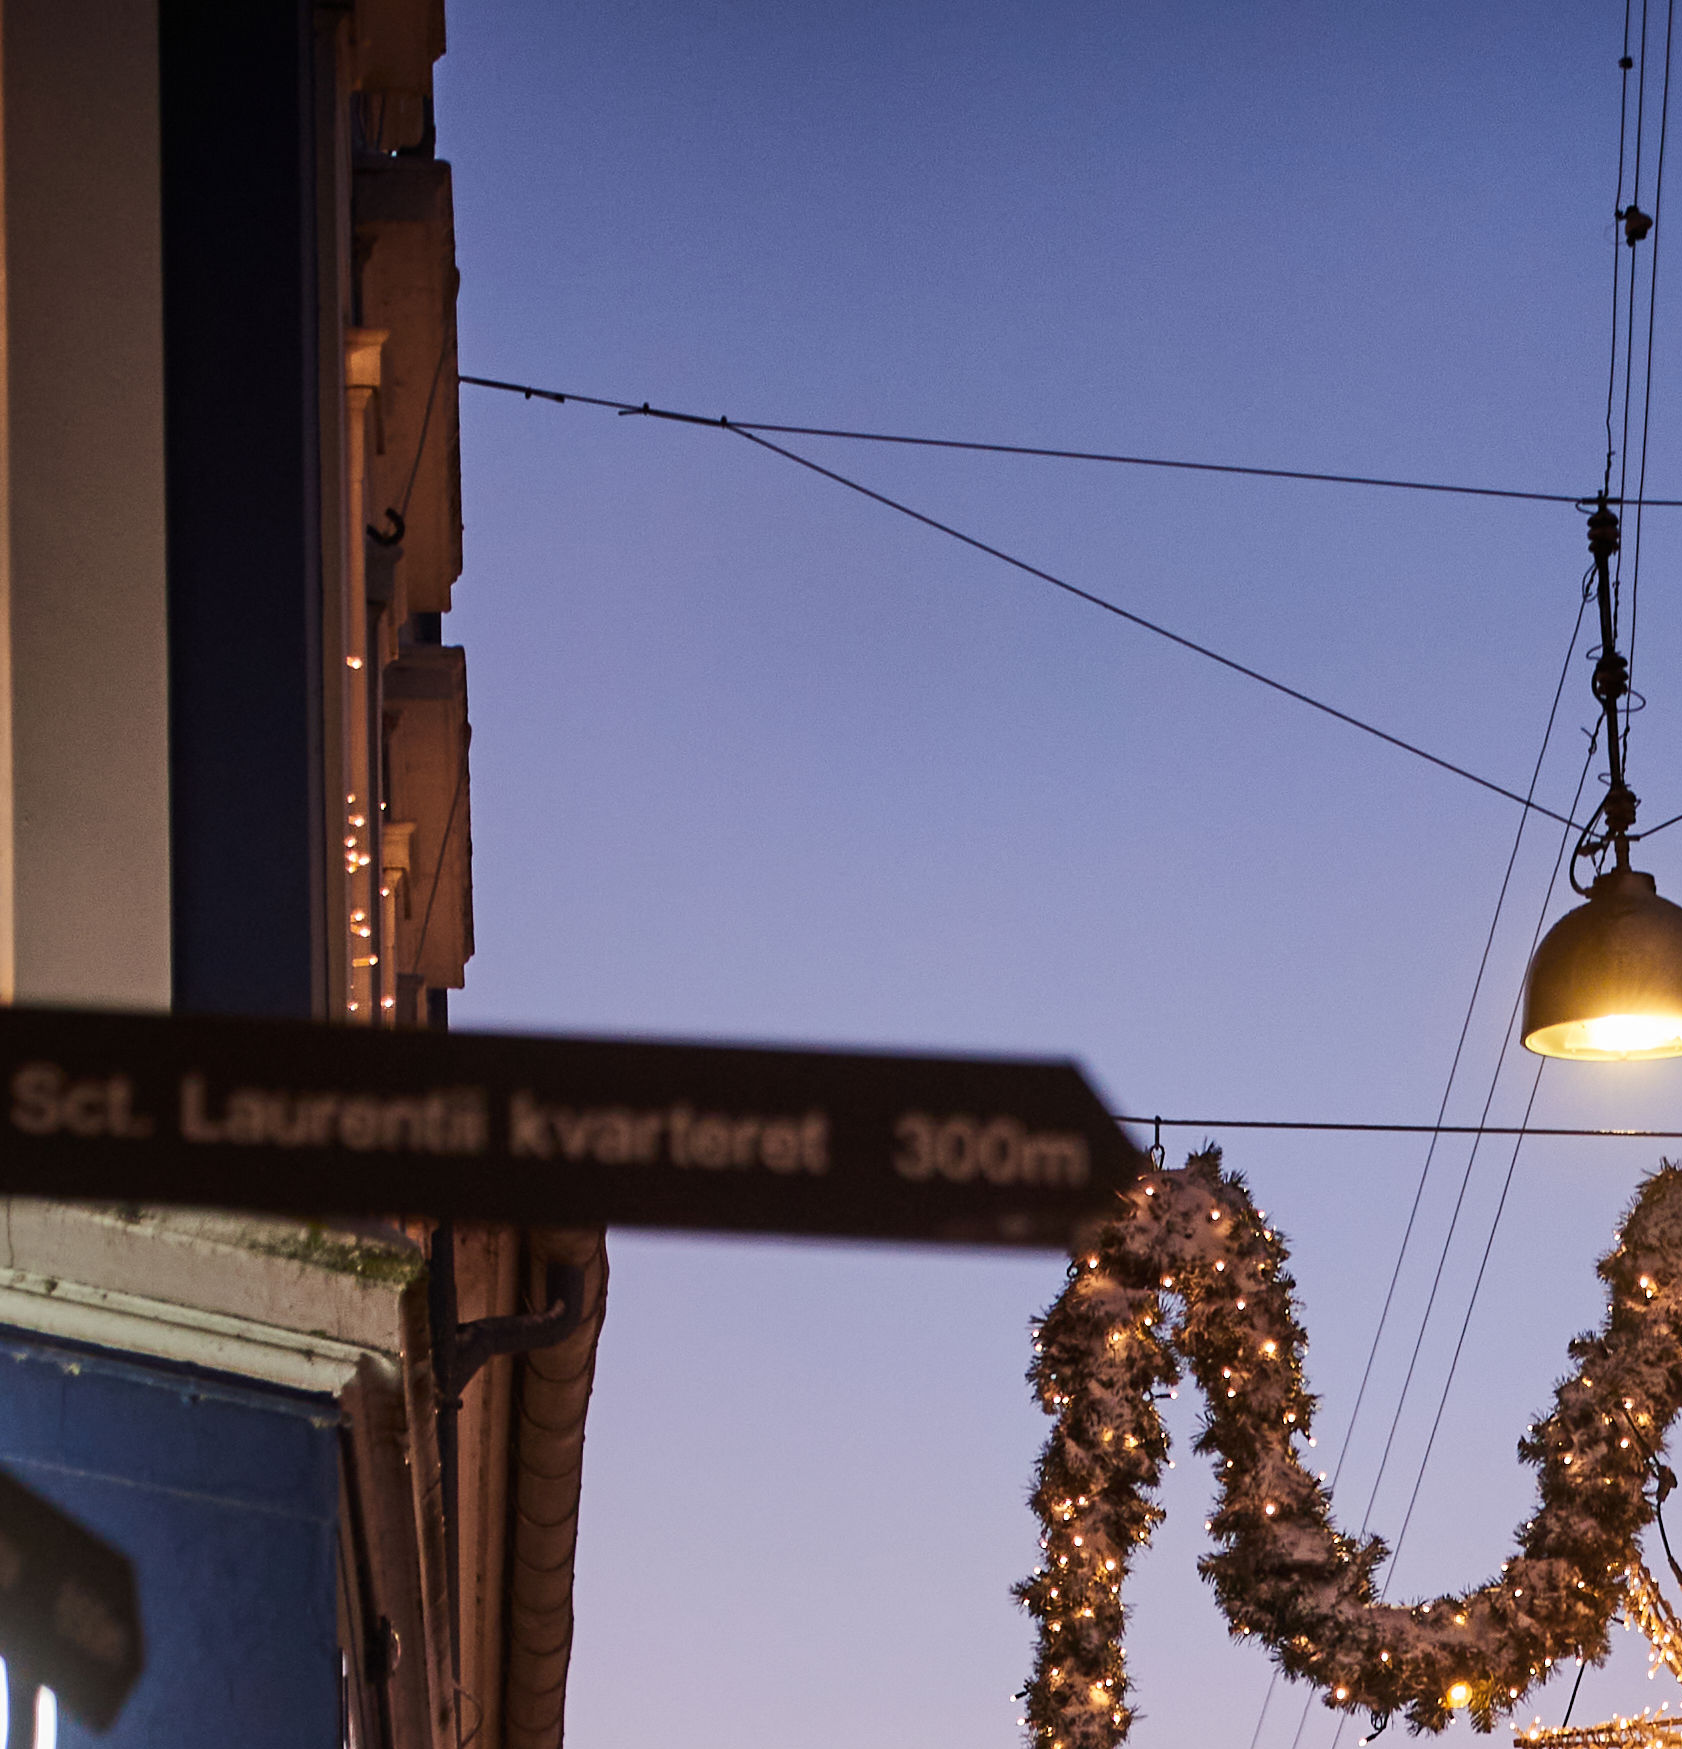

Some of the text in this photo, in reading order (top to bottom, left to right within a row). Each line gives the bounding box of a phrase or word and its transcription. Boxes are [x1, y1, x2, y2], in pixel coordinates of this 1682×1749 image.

[9, 1060, 153, 1140] Sct.
[509, 1087, 831, 1176] kvarteret
[891, 1109, 1091, 1186] 300m
